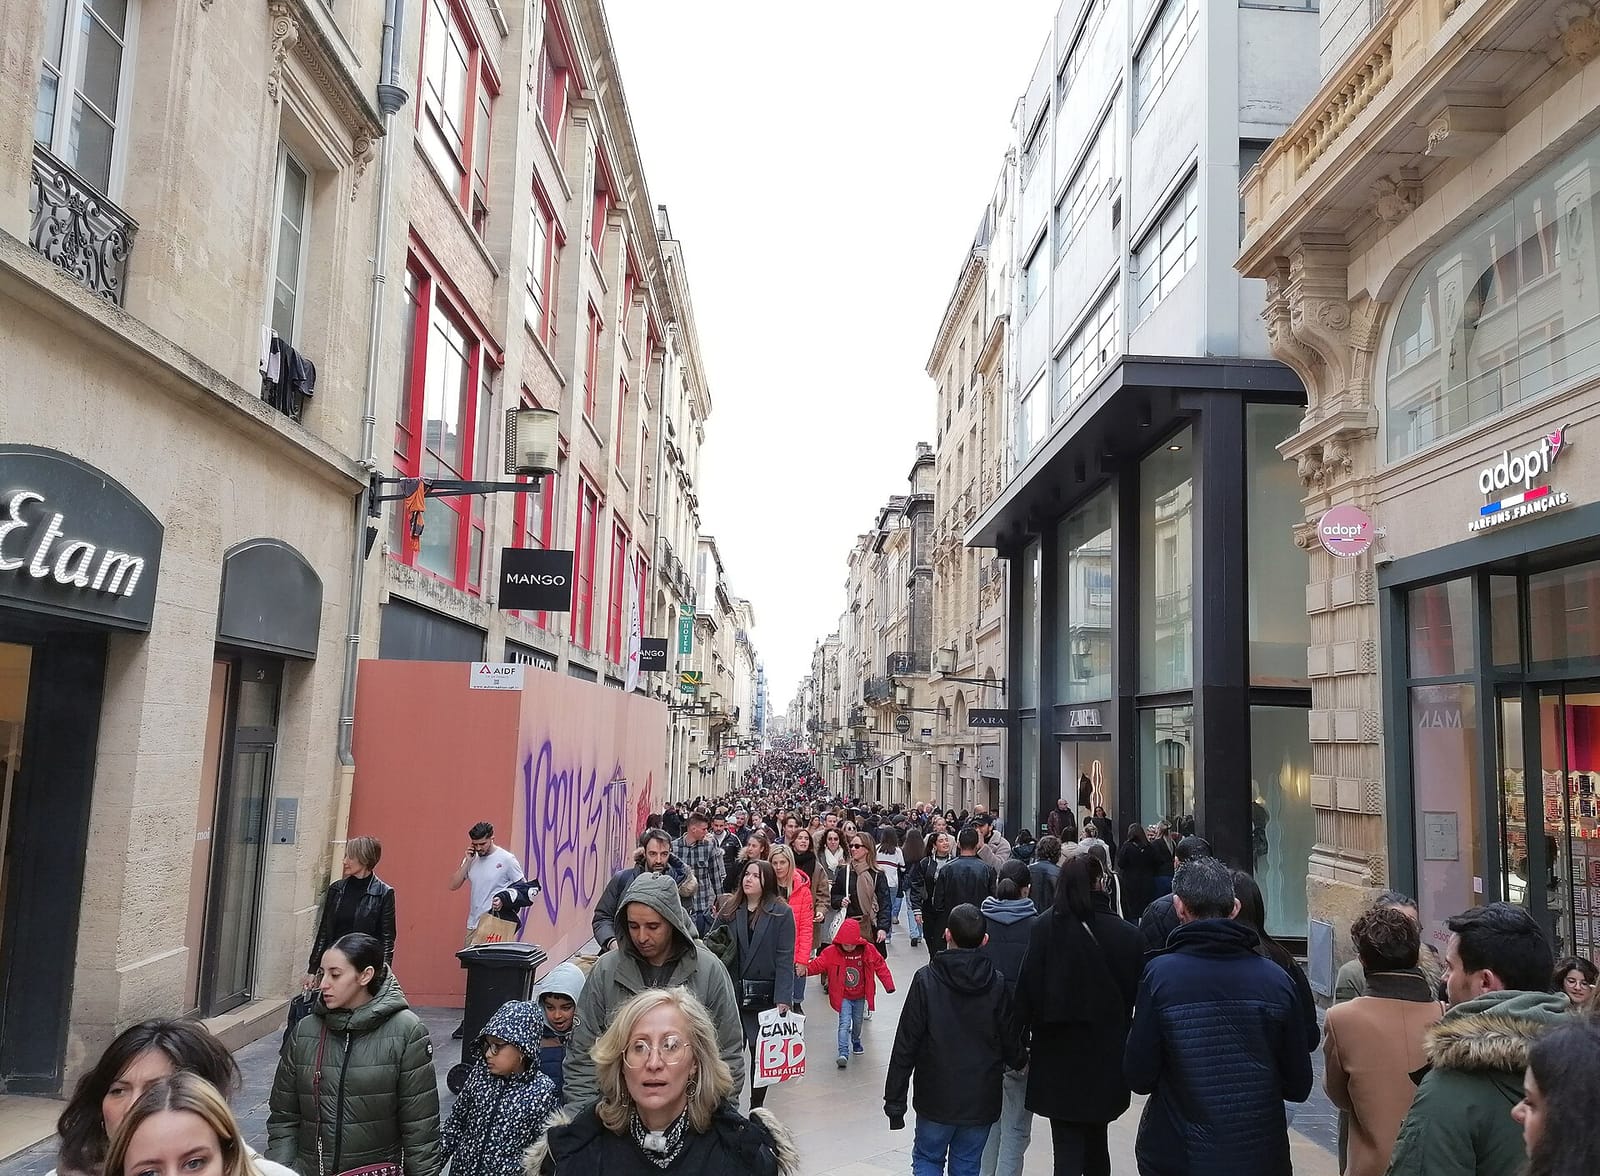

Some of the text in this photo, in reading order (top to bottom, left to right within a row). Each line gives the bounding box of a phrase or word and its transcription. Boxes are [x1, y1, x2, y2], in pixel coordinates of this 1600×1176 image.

[1479, 438, 1549, 494] adopt
[1468, 492, 1569, 532] PARFUMS FRANÇAIS
[0, 491, 145, 597] Etam
[1323, 523, 1362, 537] adopt
[506, 573, 566, 586] MANGO
[493, 667, 516, 675] AIDF
[763, 1035, 806, 1069] BD
